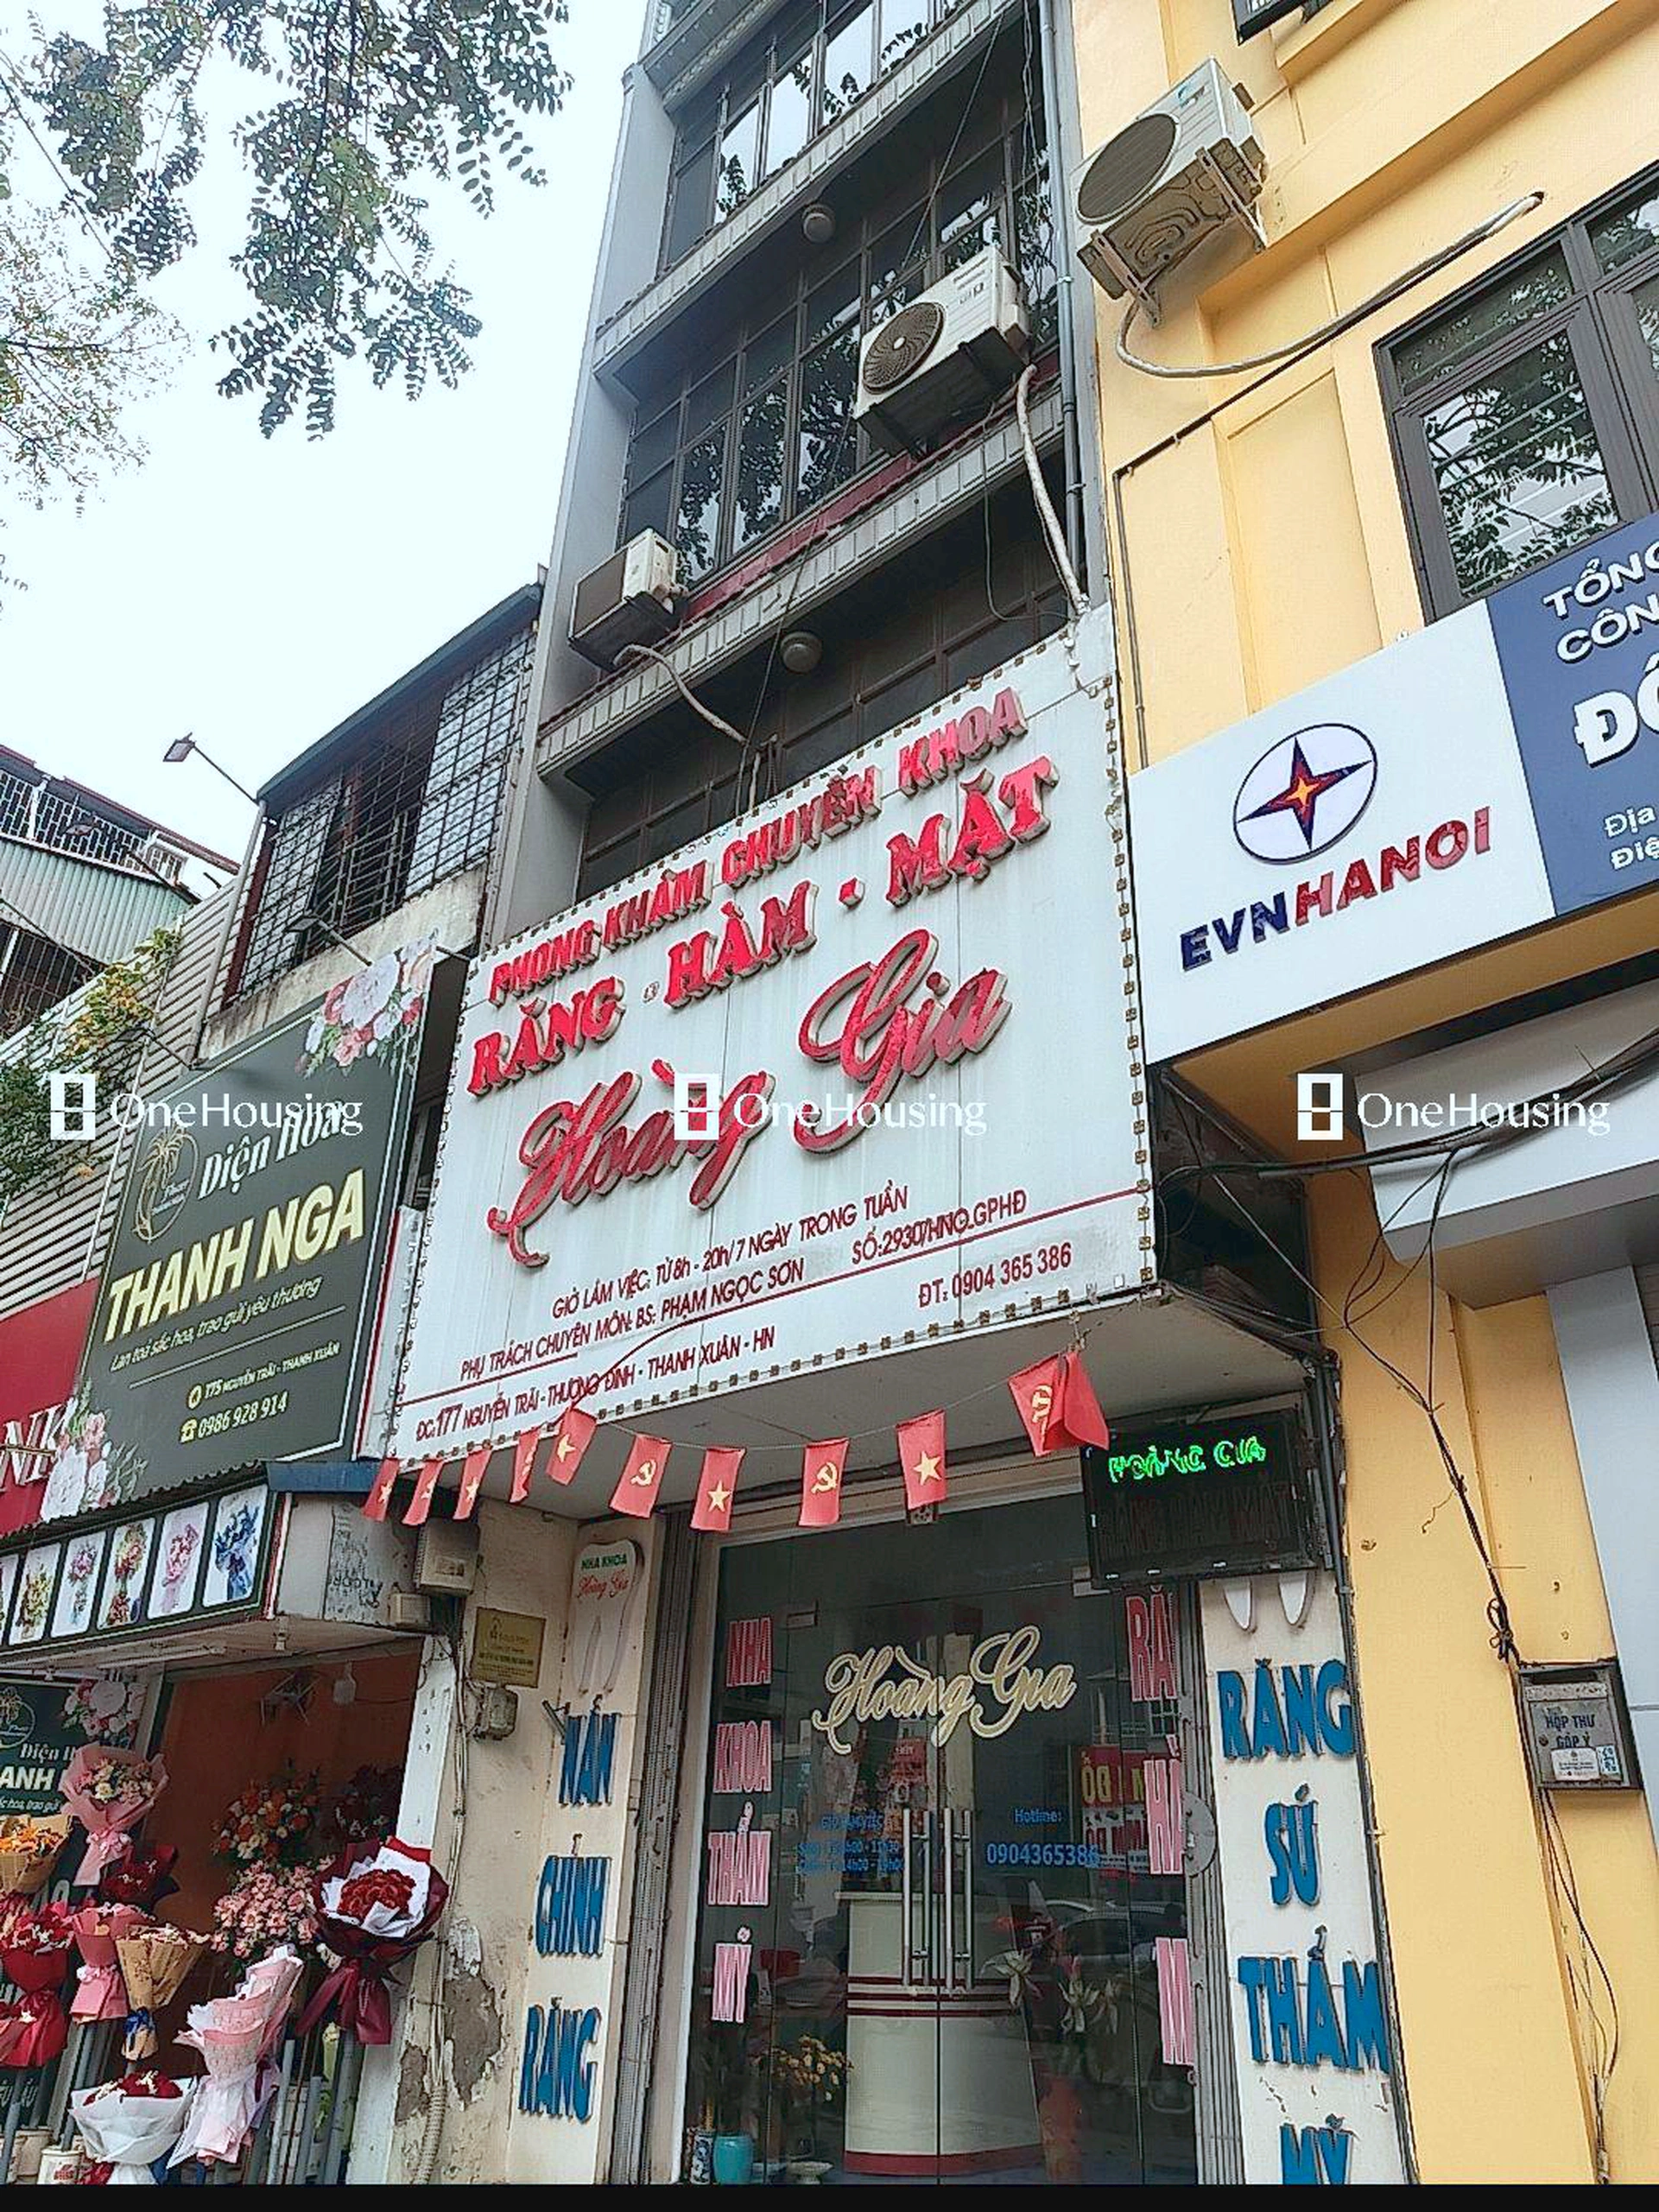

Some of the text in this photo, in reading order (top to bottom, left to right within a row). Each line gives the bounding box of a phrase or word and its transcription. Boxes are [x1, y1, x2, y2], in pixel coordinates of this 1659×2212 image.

[721, 765, 882, 888] CHUYÊN
[898, 687, 1029, 797] KHOA
[1604, 807, 1656, 838] Địa
[467, 755, 1060, 1096] RĂNG HÀM MẶT
[488, 929, 1012, 1268] Hoàng Gia
[198, 1134, 271, 1200] Diện
[748, 1222, 793, 1258] NGÀY
[799, 1203, 858, 1241] TRONG
[864, 1179, 909, 1220] TUẦN
[104, 1169, 365, 1341] THANH NGA
[918, 1242, 1073, 1308] ĐT: 0904 365 386
[460, 1354, 485, 1382] PHỤ
[489, 1340, 535, 1372] TRÁCH
[535, 1321, 592, 1358] CHUYÊN
[636, 1303, 657, 1329] BS:
[661, 1287, 708, 1322] PHẠM
[711, 1270, 763, 1307] NGỌC
[768, 1257, 805, 1290] SƠN
[463, 1391, 511, 1429] NGUYỄN
[648, 1347, 696, 1379] THANH
[700, 1334, 742, 1366] XUÂN
[752, 1325, 776, 1353] HN
[198, 1391, 289, 1439] 0986 928 914
[812, 1625, 1077, 1754] Hoàng Gia
[1216, 1657, 1357, 1760] RĂNG
[712, 1720, 771, 1793] KHOA
[1264, 1784, 1320, 1906] SỨ
[1238, 1924, 1391, 2072] THẨM
[517, 1997, 602, 2122] RĂNG
